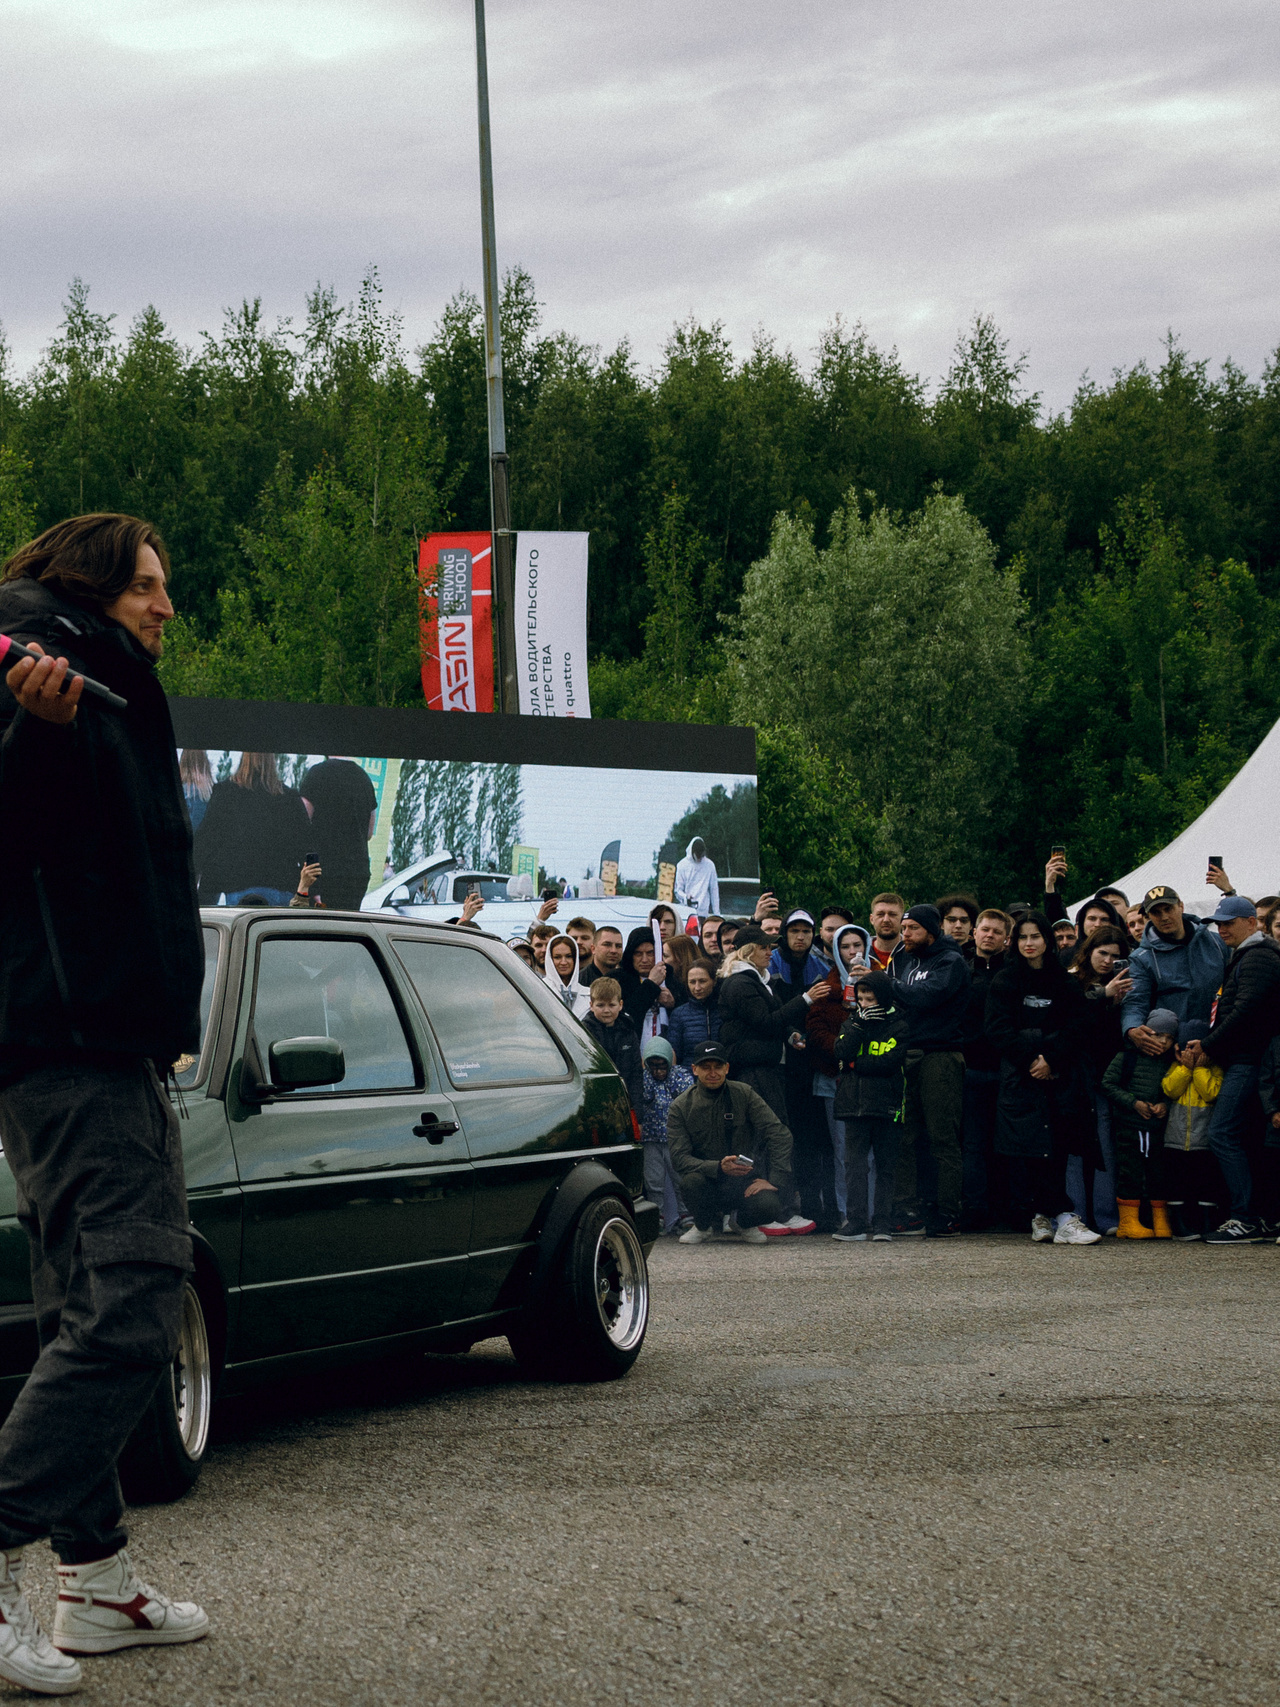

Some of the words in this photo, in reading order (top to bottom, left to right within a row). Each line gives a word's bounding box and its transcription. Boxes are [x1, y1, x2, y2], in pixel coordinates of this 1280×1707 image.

[455, 554, 467, 611] SCHOOL
[527, 549, 540, 683] ВОДИТЕЛЬСКОГО
[563, 652, 576, 707] quattro
[1148, 887, 1165, 900] W
[172, 1057, 196, 1068] NER
